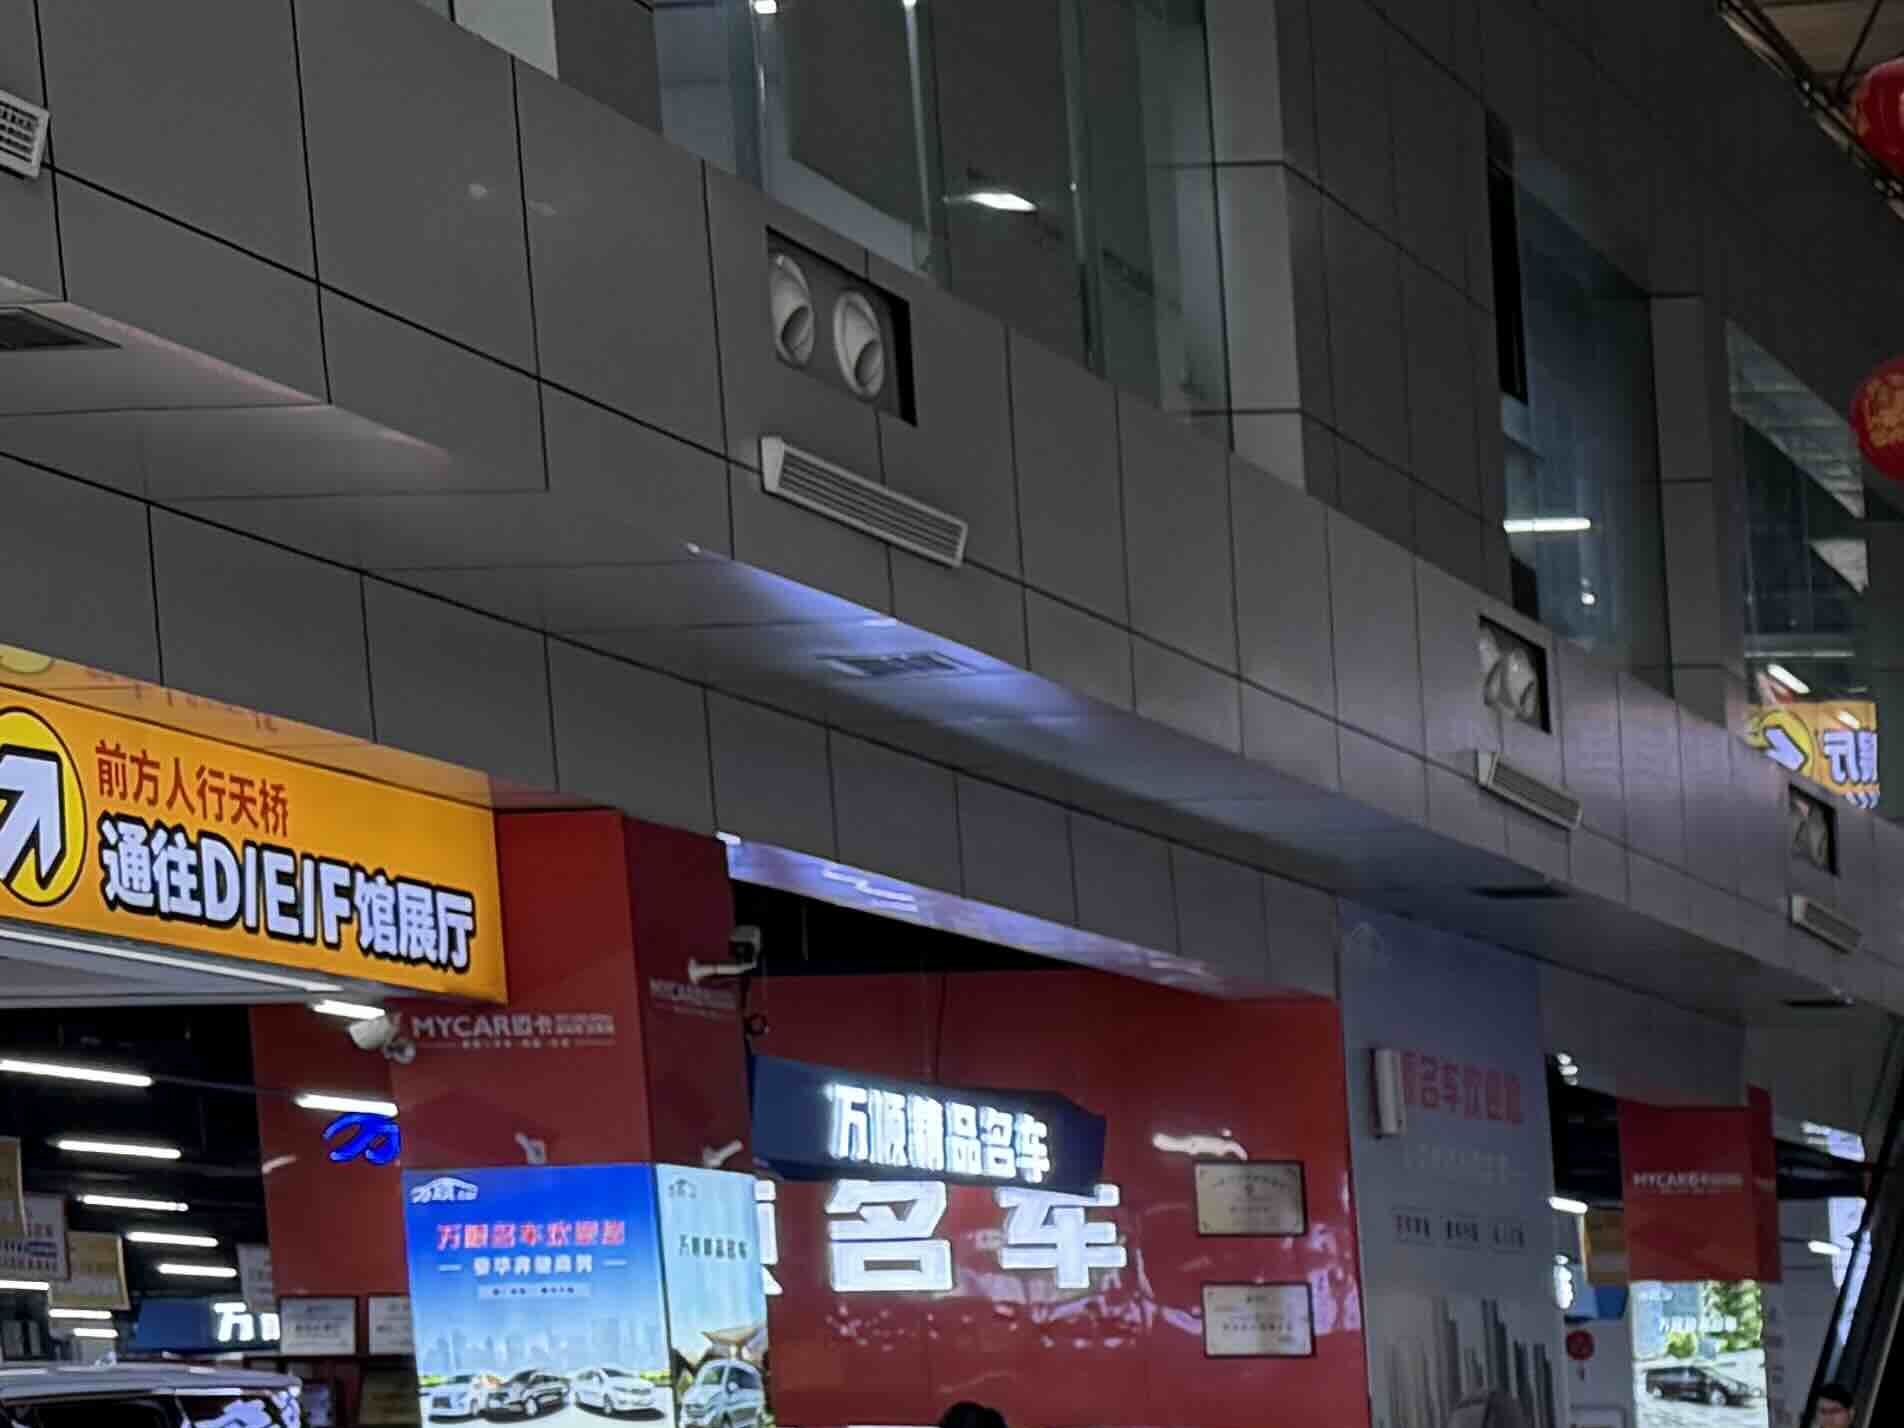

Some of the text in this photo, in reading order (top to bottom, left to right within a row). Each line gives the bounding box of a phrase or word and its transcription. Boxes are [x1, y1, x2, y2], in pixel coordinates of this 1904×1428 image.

[95, 739, 290, 838] 前方人行天桥
